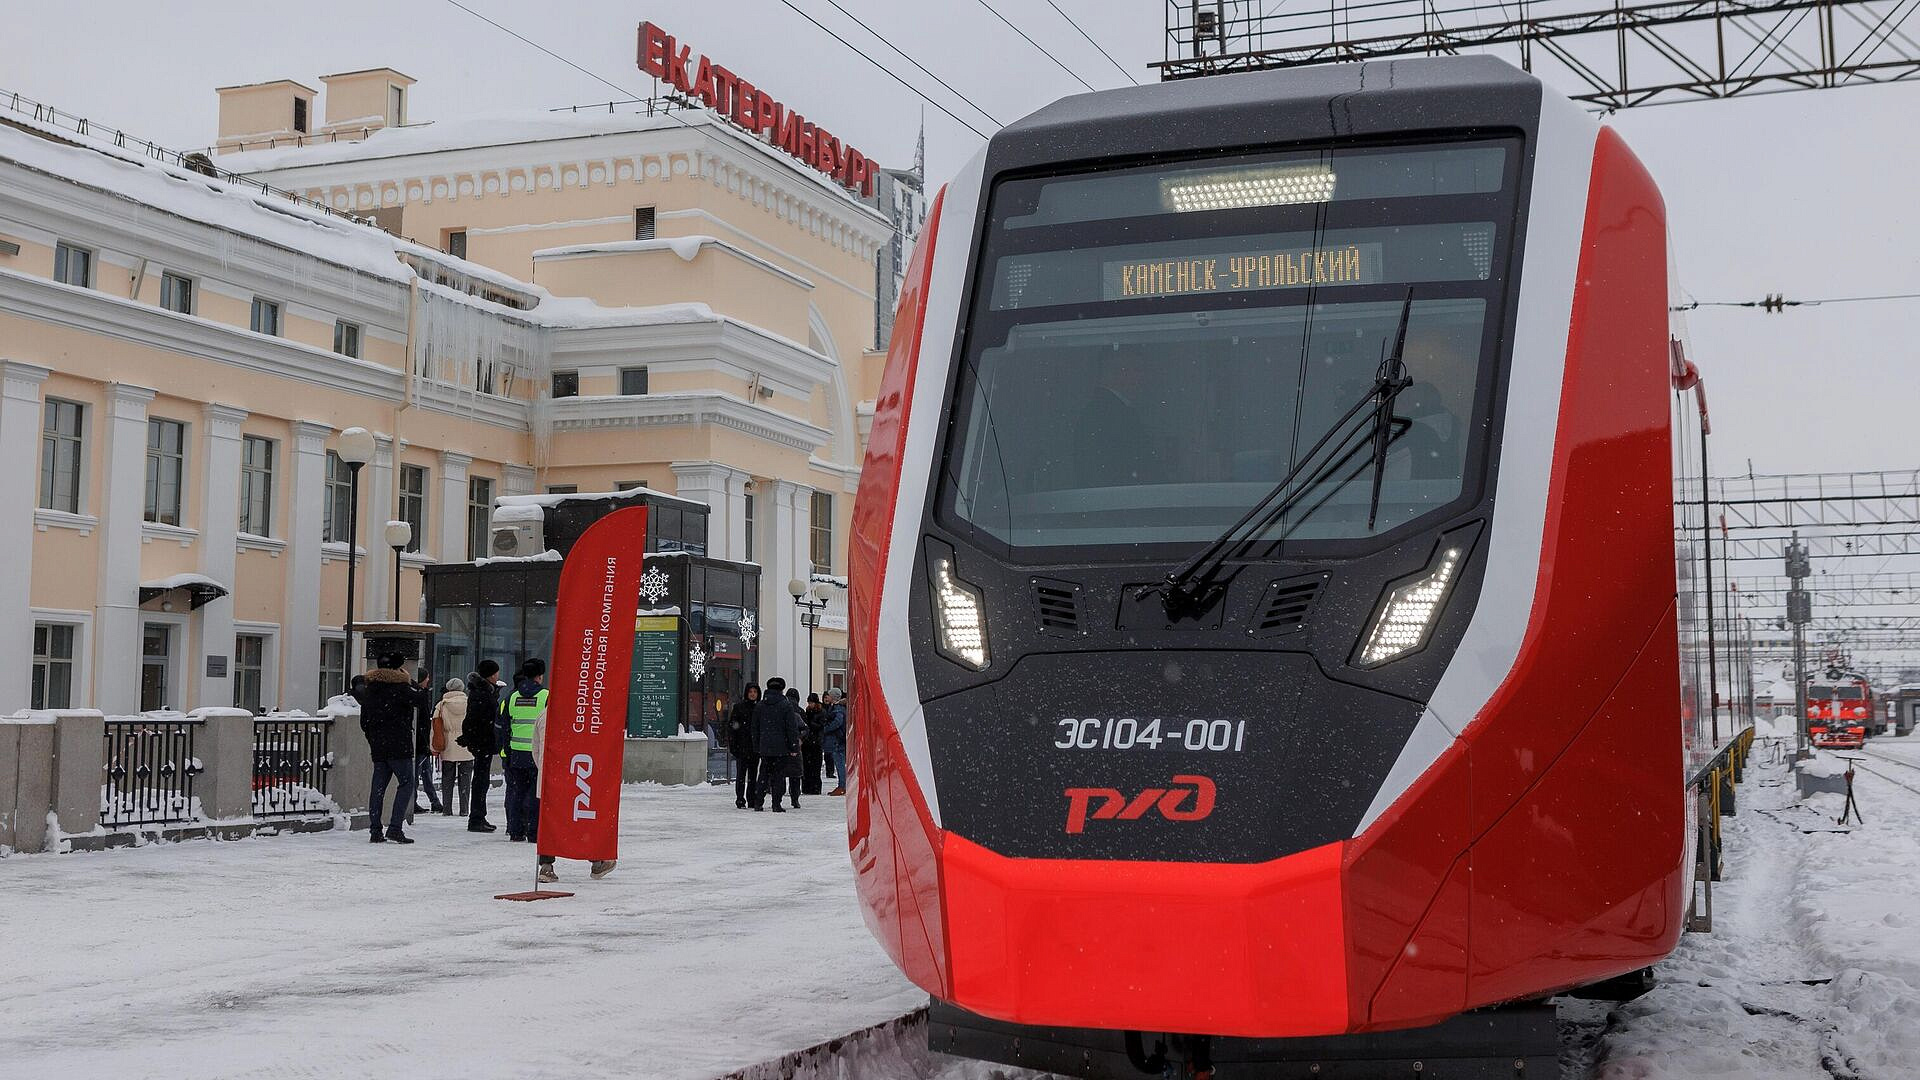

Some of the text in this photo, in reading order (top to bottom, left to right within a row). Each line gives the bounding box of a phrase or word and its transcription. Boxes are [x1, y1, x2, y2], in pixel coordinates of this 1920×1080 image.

[637, 21, 881, 197] ЕКАТЕРИНБУРГ
[1123, 246, 1360, 296] КАМЕНСК-УРАЛЬСКИЙ
[590, 557, 617, 734] пригородная компания
[636, 673, 642, 682] 2
[572, 629, 594, 733] Свердловская
[570, 753, 597, 823] РЖД
[1064, 774, 1217, 835] РЖД
